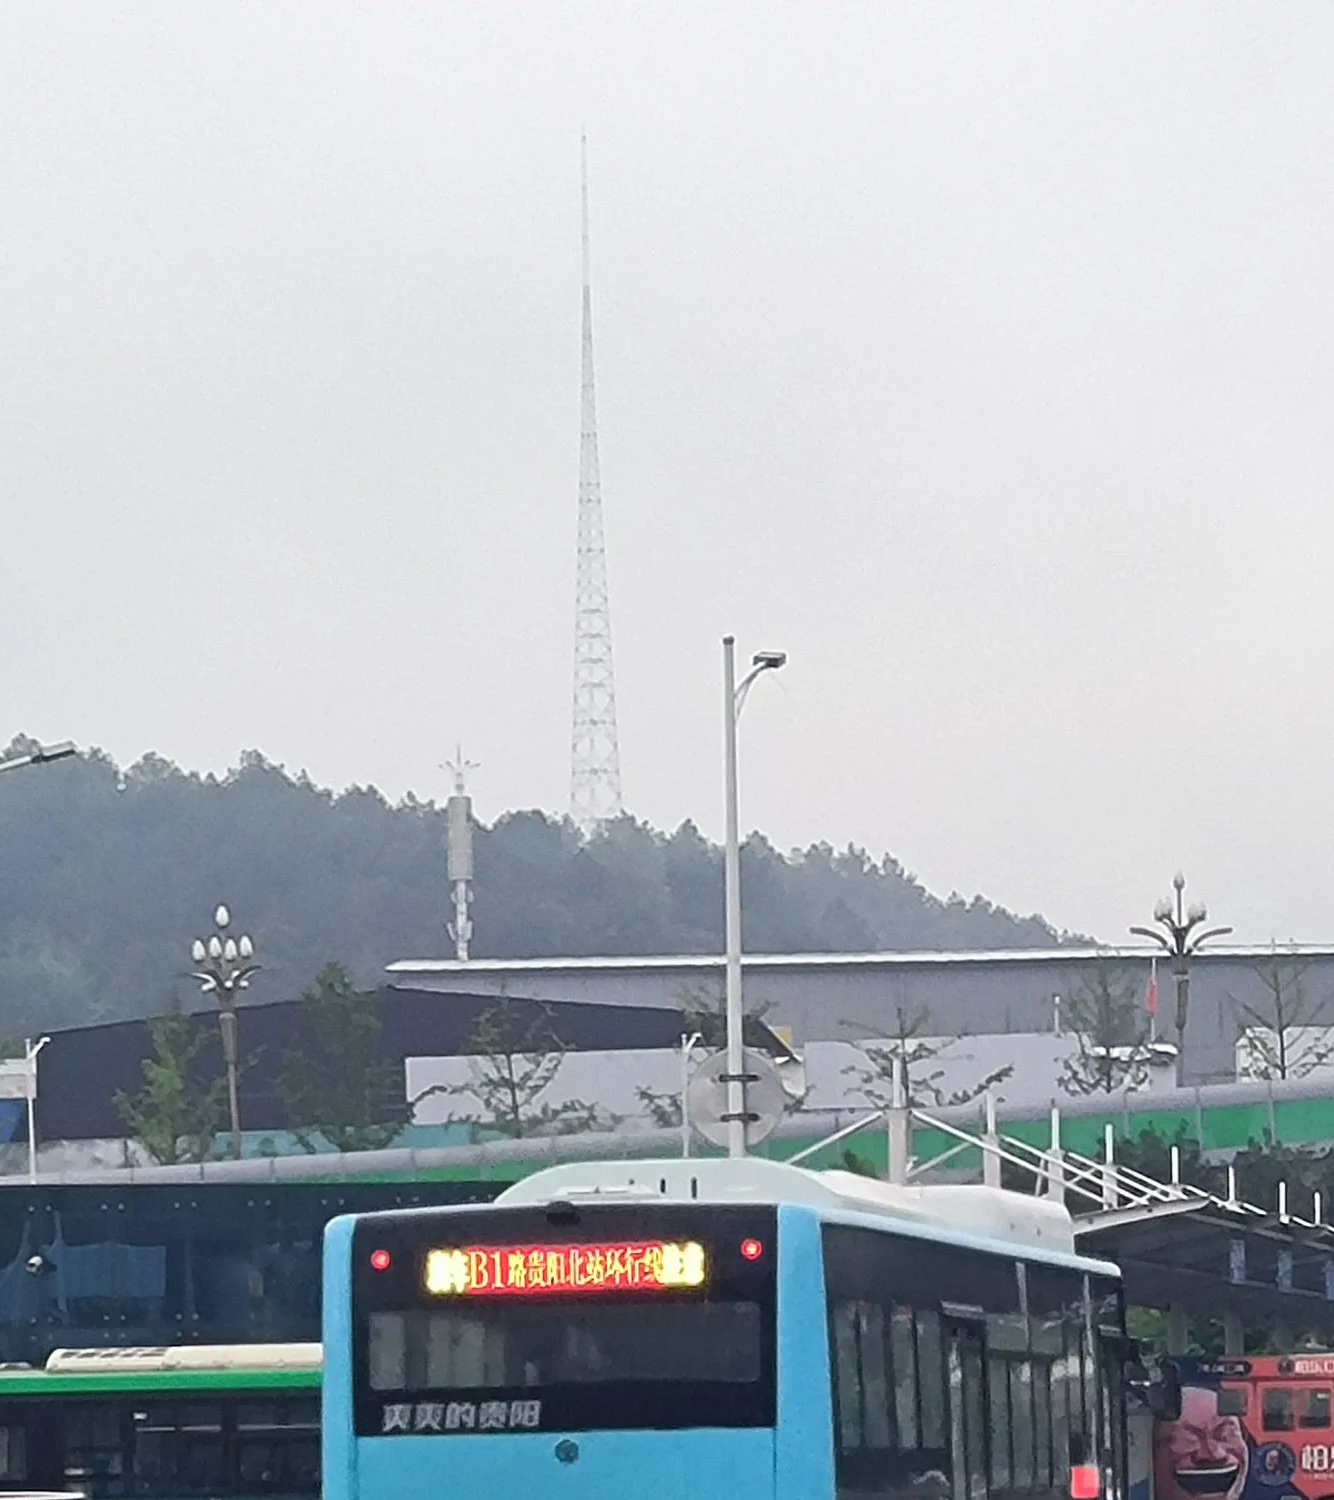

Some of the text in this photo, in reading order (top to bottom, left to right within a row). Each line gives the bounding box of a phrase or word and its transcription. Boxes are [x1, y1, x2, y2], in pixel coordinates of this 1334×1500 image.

[381, 1400, 542, 1432] 爽爽的贵阳
